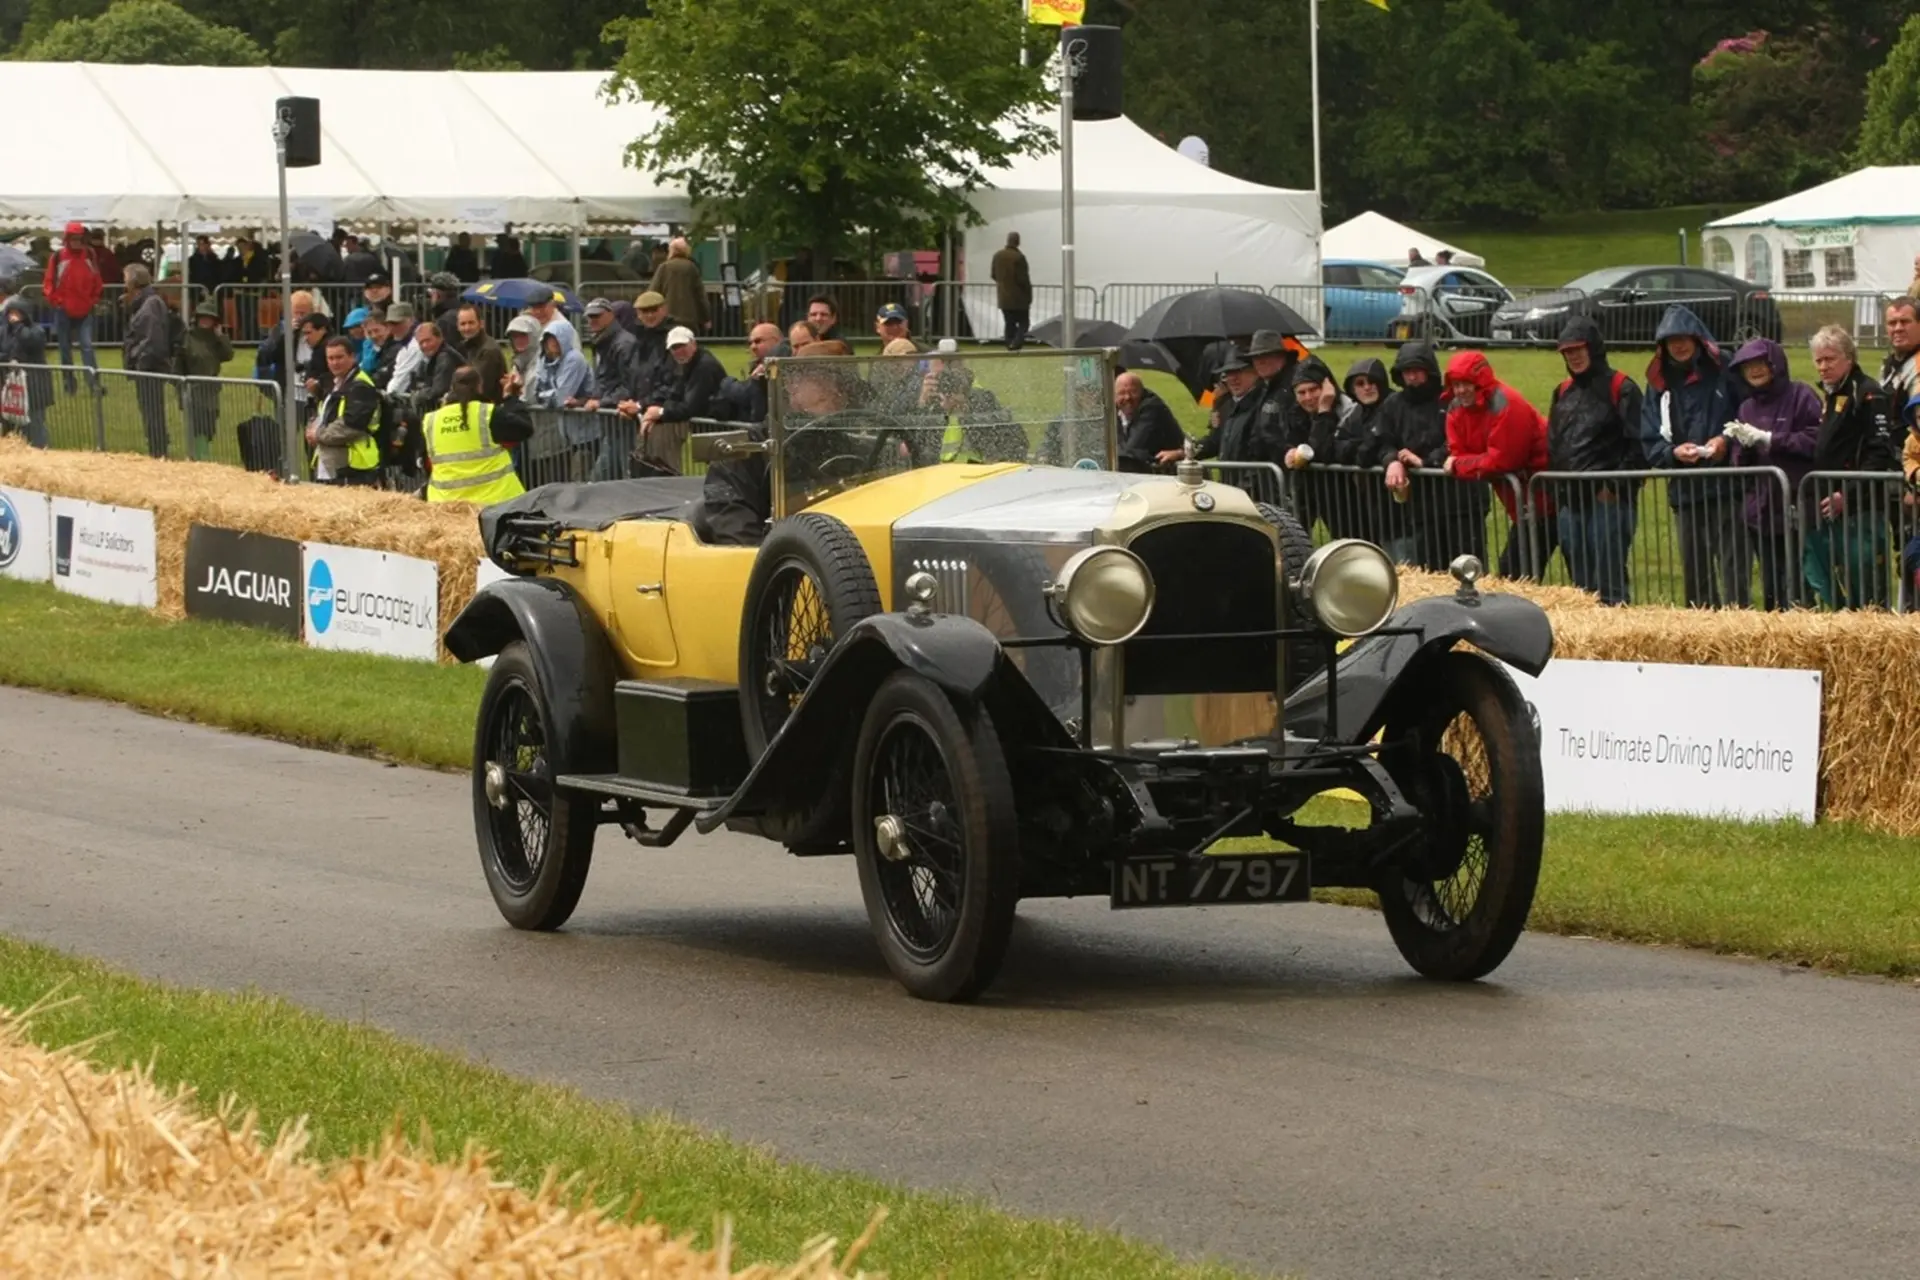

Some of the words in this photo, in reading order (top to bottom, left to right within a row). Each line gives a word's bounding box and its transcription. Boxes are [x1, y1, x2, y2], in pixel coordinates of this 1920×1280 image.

[197, 565, 291, 608] JAGUAR
[1559, 727, 1586, 758] The
[1590, 730, 1652, 763] Ultimate
[1656, 734, 1712, 774] Driving
[1716, 738, 1794, 773] Machine
[1122, 862, 1176, 902] NT
[1190, 859, 1299, 899] 7797
